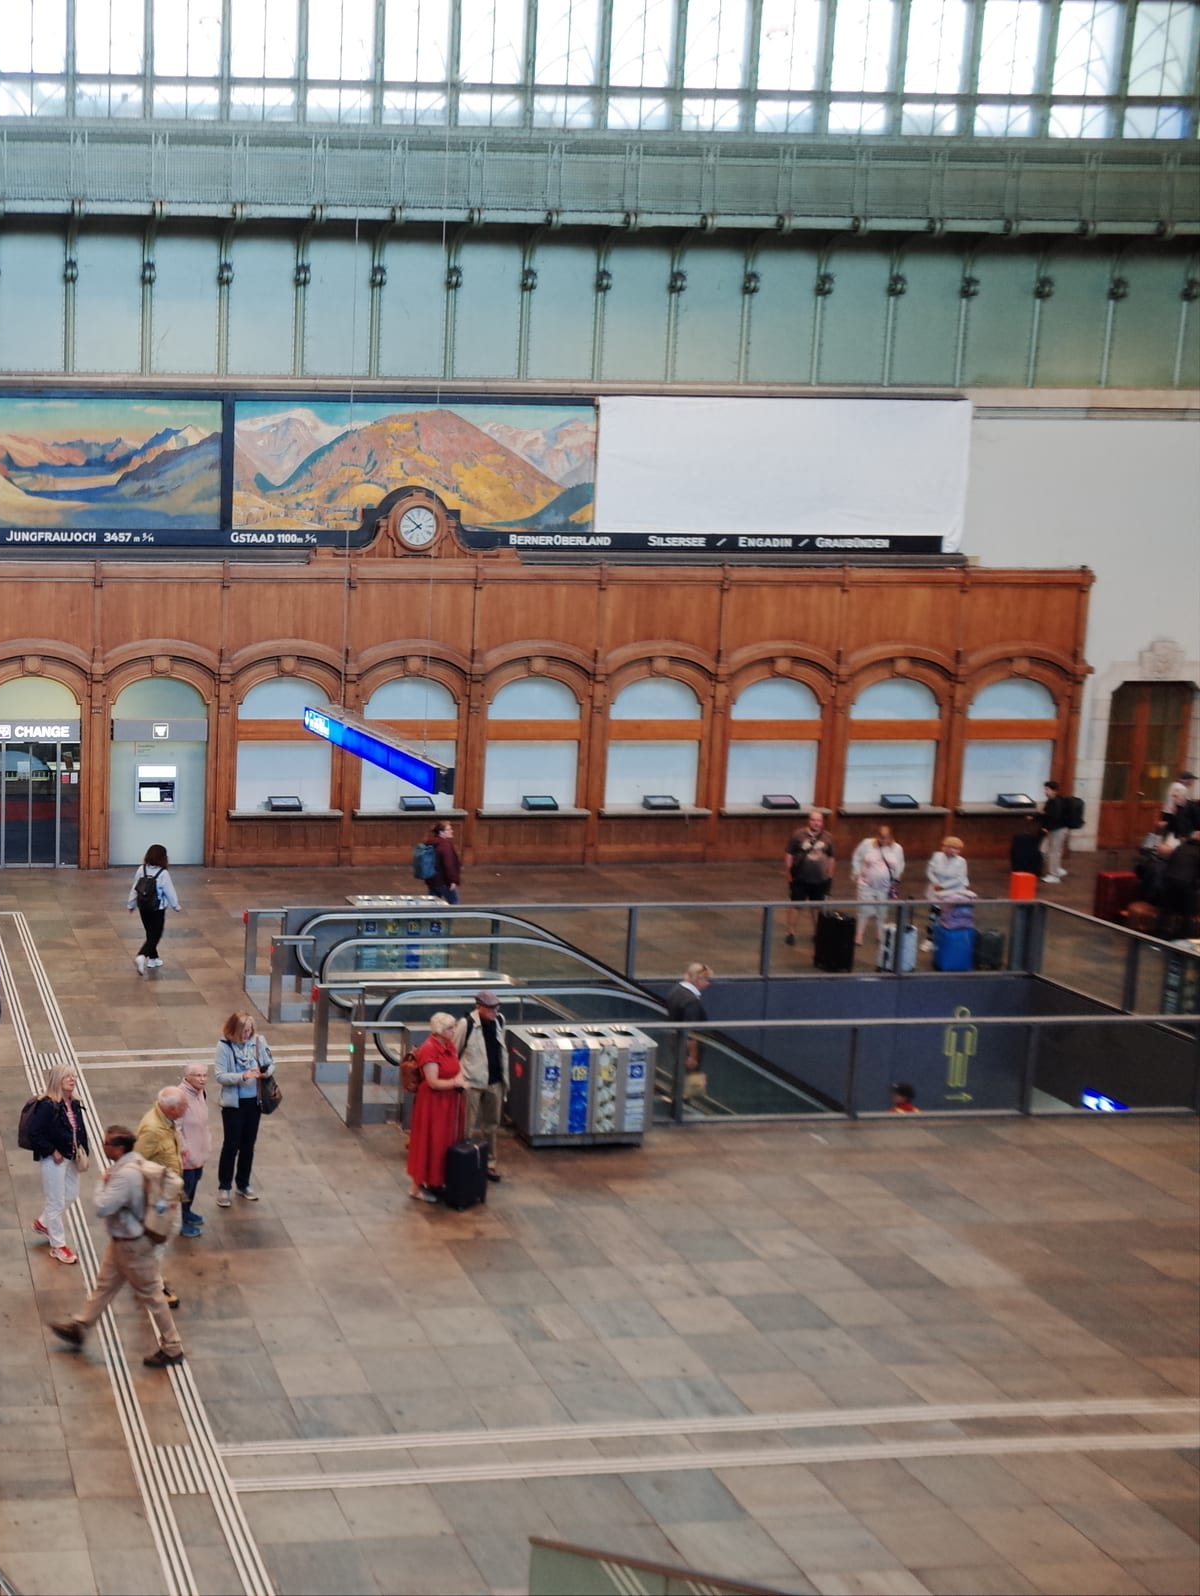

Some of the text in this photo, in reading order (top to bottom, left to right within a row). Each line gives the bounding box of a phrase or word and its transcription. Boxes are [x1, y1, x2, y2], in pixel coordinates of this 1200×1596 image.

[5, 530, 96, 543] JUNGFRAUJOCH
[103, 532, 131, 543] 3457
[230, 532, 275, 543] GSTAAD
[647, 535, 707, 547] SILSERSEE
[737, 536, 793, 548] ENGADIN
[14, 725, 70, 738] CHANGE
